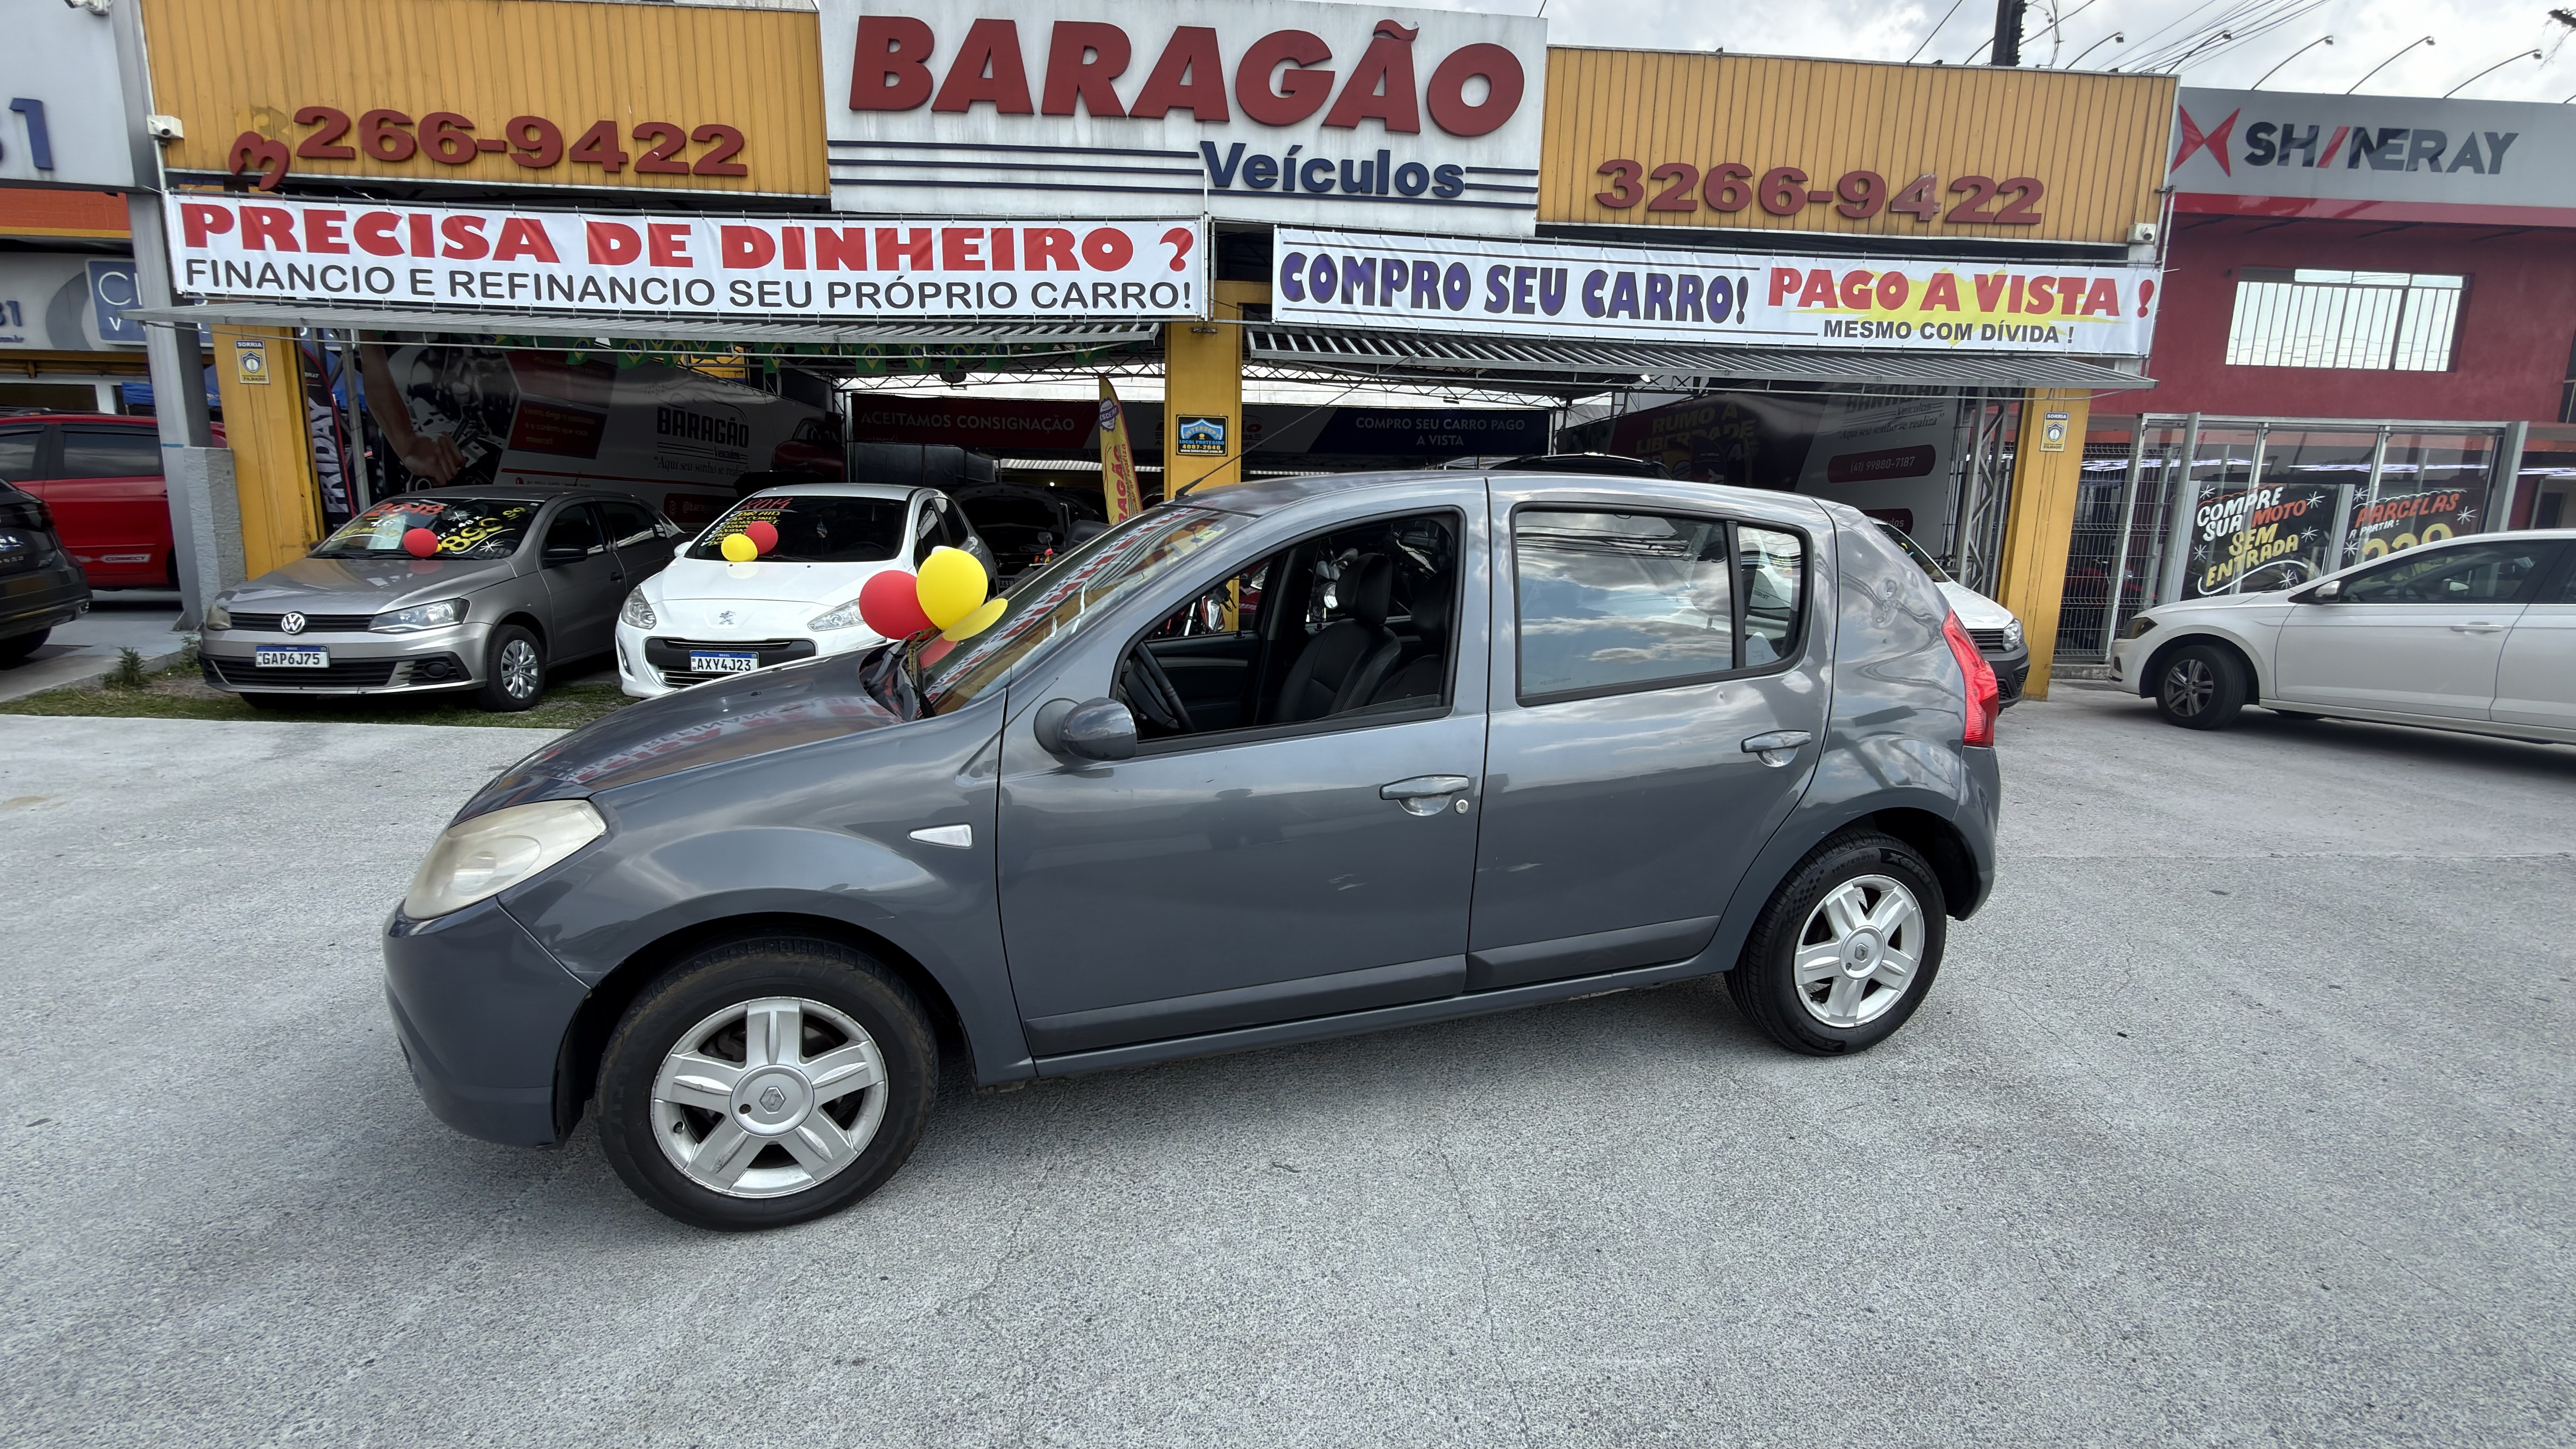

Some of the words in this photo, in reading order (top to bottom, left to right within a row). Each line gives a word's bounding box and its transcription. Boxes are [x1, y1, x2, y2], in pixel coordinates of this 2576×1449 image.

[849, 18, 1524, 137] BARAGÃO
[1200, 140, 1464, 198] Veículos
[1594, 158, 2044, 225] 3266-9422
[180, 203, 561, 264] PRECISA
[586, 220, 693, 268] DE
[720, 225, 1134, 272] DINHEIRO
[1159, 227, 1194, 272] ?
[186, 259, 395, 294] FINANCIO
[410, 268, 435, 296] E
[449, 270, 715, 307] REFINANCIO
[729, 279, 812, 308] SEU
[828, 275, 1017, 309] PRÓPRIO
[1031, 281, 1191, 309] CARRO!
[1279, 251, 1471, 312] COMPRO
[1484, 264, 1568, 316] SEU
[1581, 269, 1749, 325] CARRO!
[1768, 267, 1909, 311] PAGO
[1919, 272, 1960, 312] A
[1974, 274, 2120, 318] VISTA
[2137, 279, 2154, 318] !
[1823, 320, 1912, 339] MESMO
[1920, 322, 1973, 341] COM
[1980, 320, 2059, 344] DÍVIDA
[657, 406, 749, 448] BARAGÃO
[861, 411, 951, 428] ACEITAMOS
[956, 414, 1075, 434] CONSIGNAÇÃO
[1356, 417, 1412, 429] COMPRO
[1416, 419, 1439, 430] SEU
[1443, 419, 1487, 431] CARRO
[1490, 420, 1525, 431] PAGO
[1652, 406, 1715, 434] RUMO
[1721, 401, 1738, 421] A
[1416, 435, 1425, 445] A
[1428, 435, 1464, 446] VISTA
[680, 461, 692, 471] seu
[695, 461, 716, 473] sonho
[362, 503, 444, 516] 2018
[738, 498, 793, 510] 2014
[2197, 487, 2284, 527] COMPRE
[2203, 515, 2244, 541] SUA
[2251, 500, 2307, 528] MOTO
[2355, 493, 2460, 528] PARCELAS
[2228, 523, 2279, 556] SEM
[2206, 534, 2299, 587] ENTRADA
[263, 653, 320, 665] GAP6J75
[697, 658, 751, 671] AXY4J23
